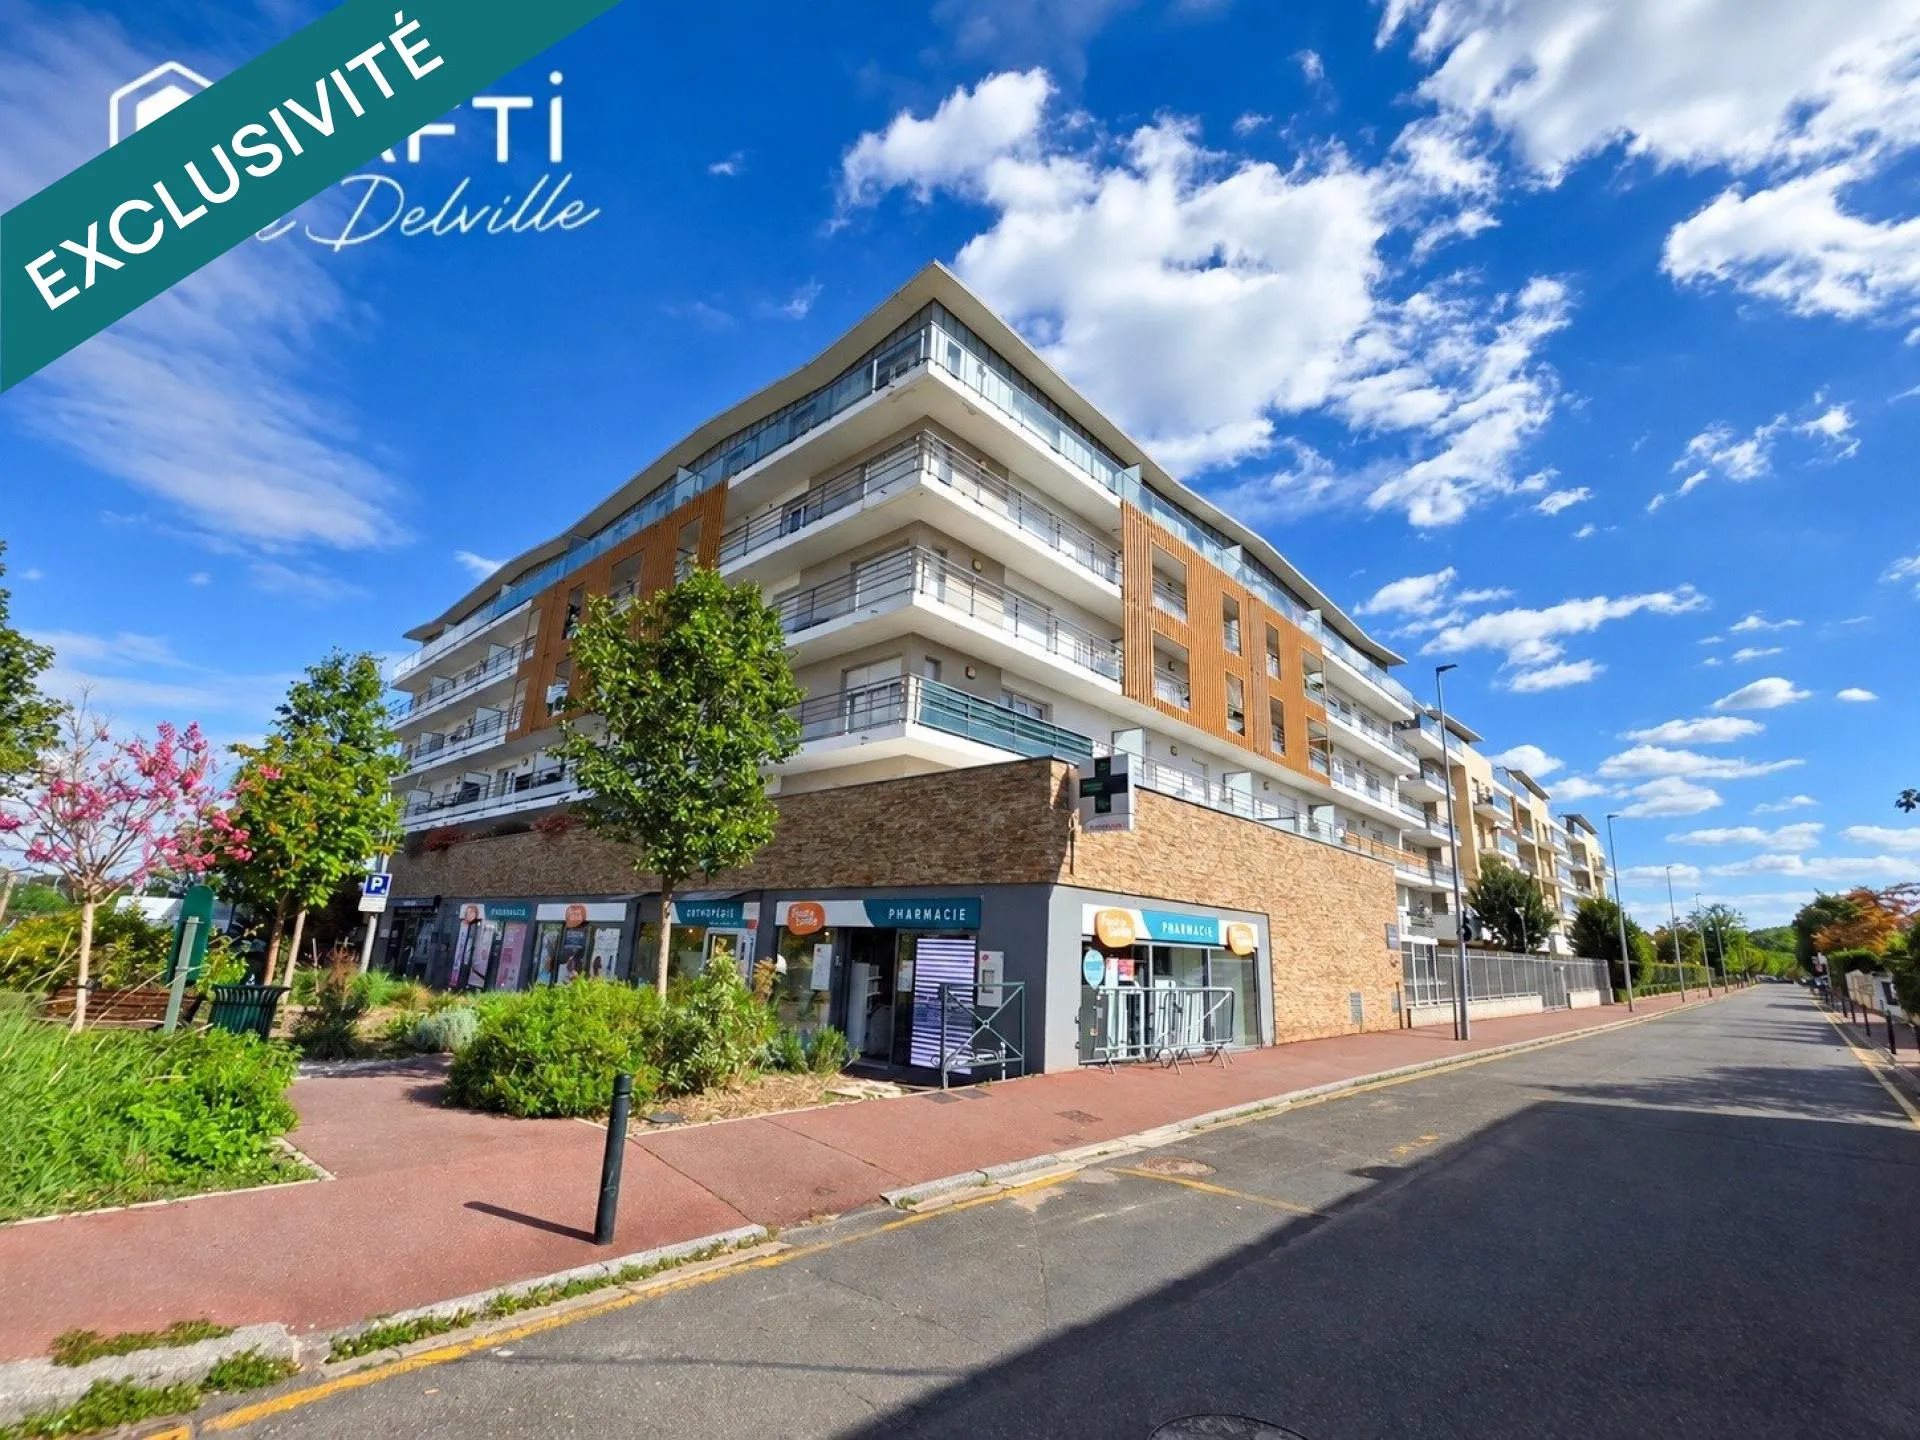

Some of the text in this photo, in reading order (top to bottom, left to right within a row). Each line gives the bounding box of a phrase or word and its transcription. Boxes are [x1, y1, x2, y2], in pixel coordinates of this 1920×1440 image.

[370, 877, 383, 891] P
[888, 907, 966, 920] PHARMACIE
[1162, 921, 1213, 937] PHARMACIE
